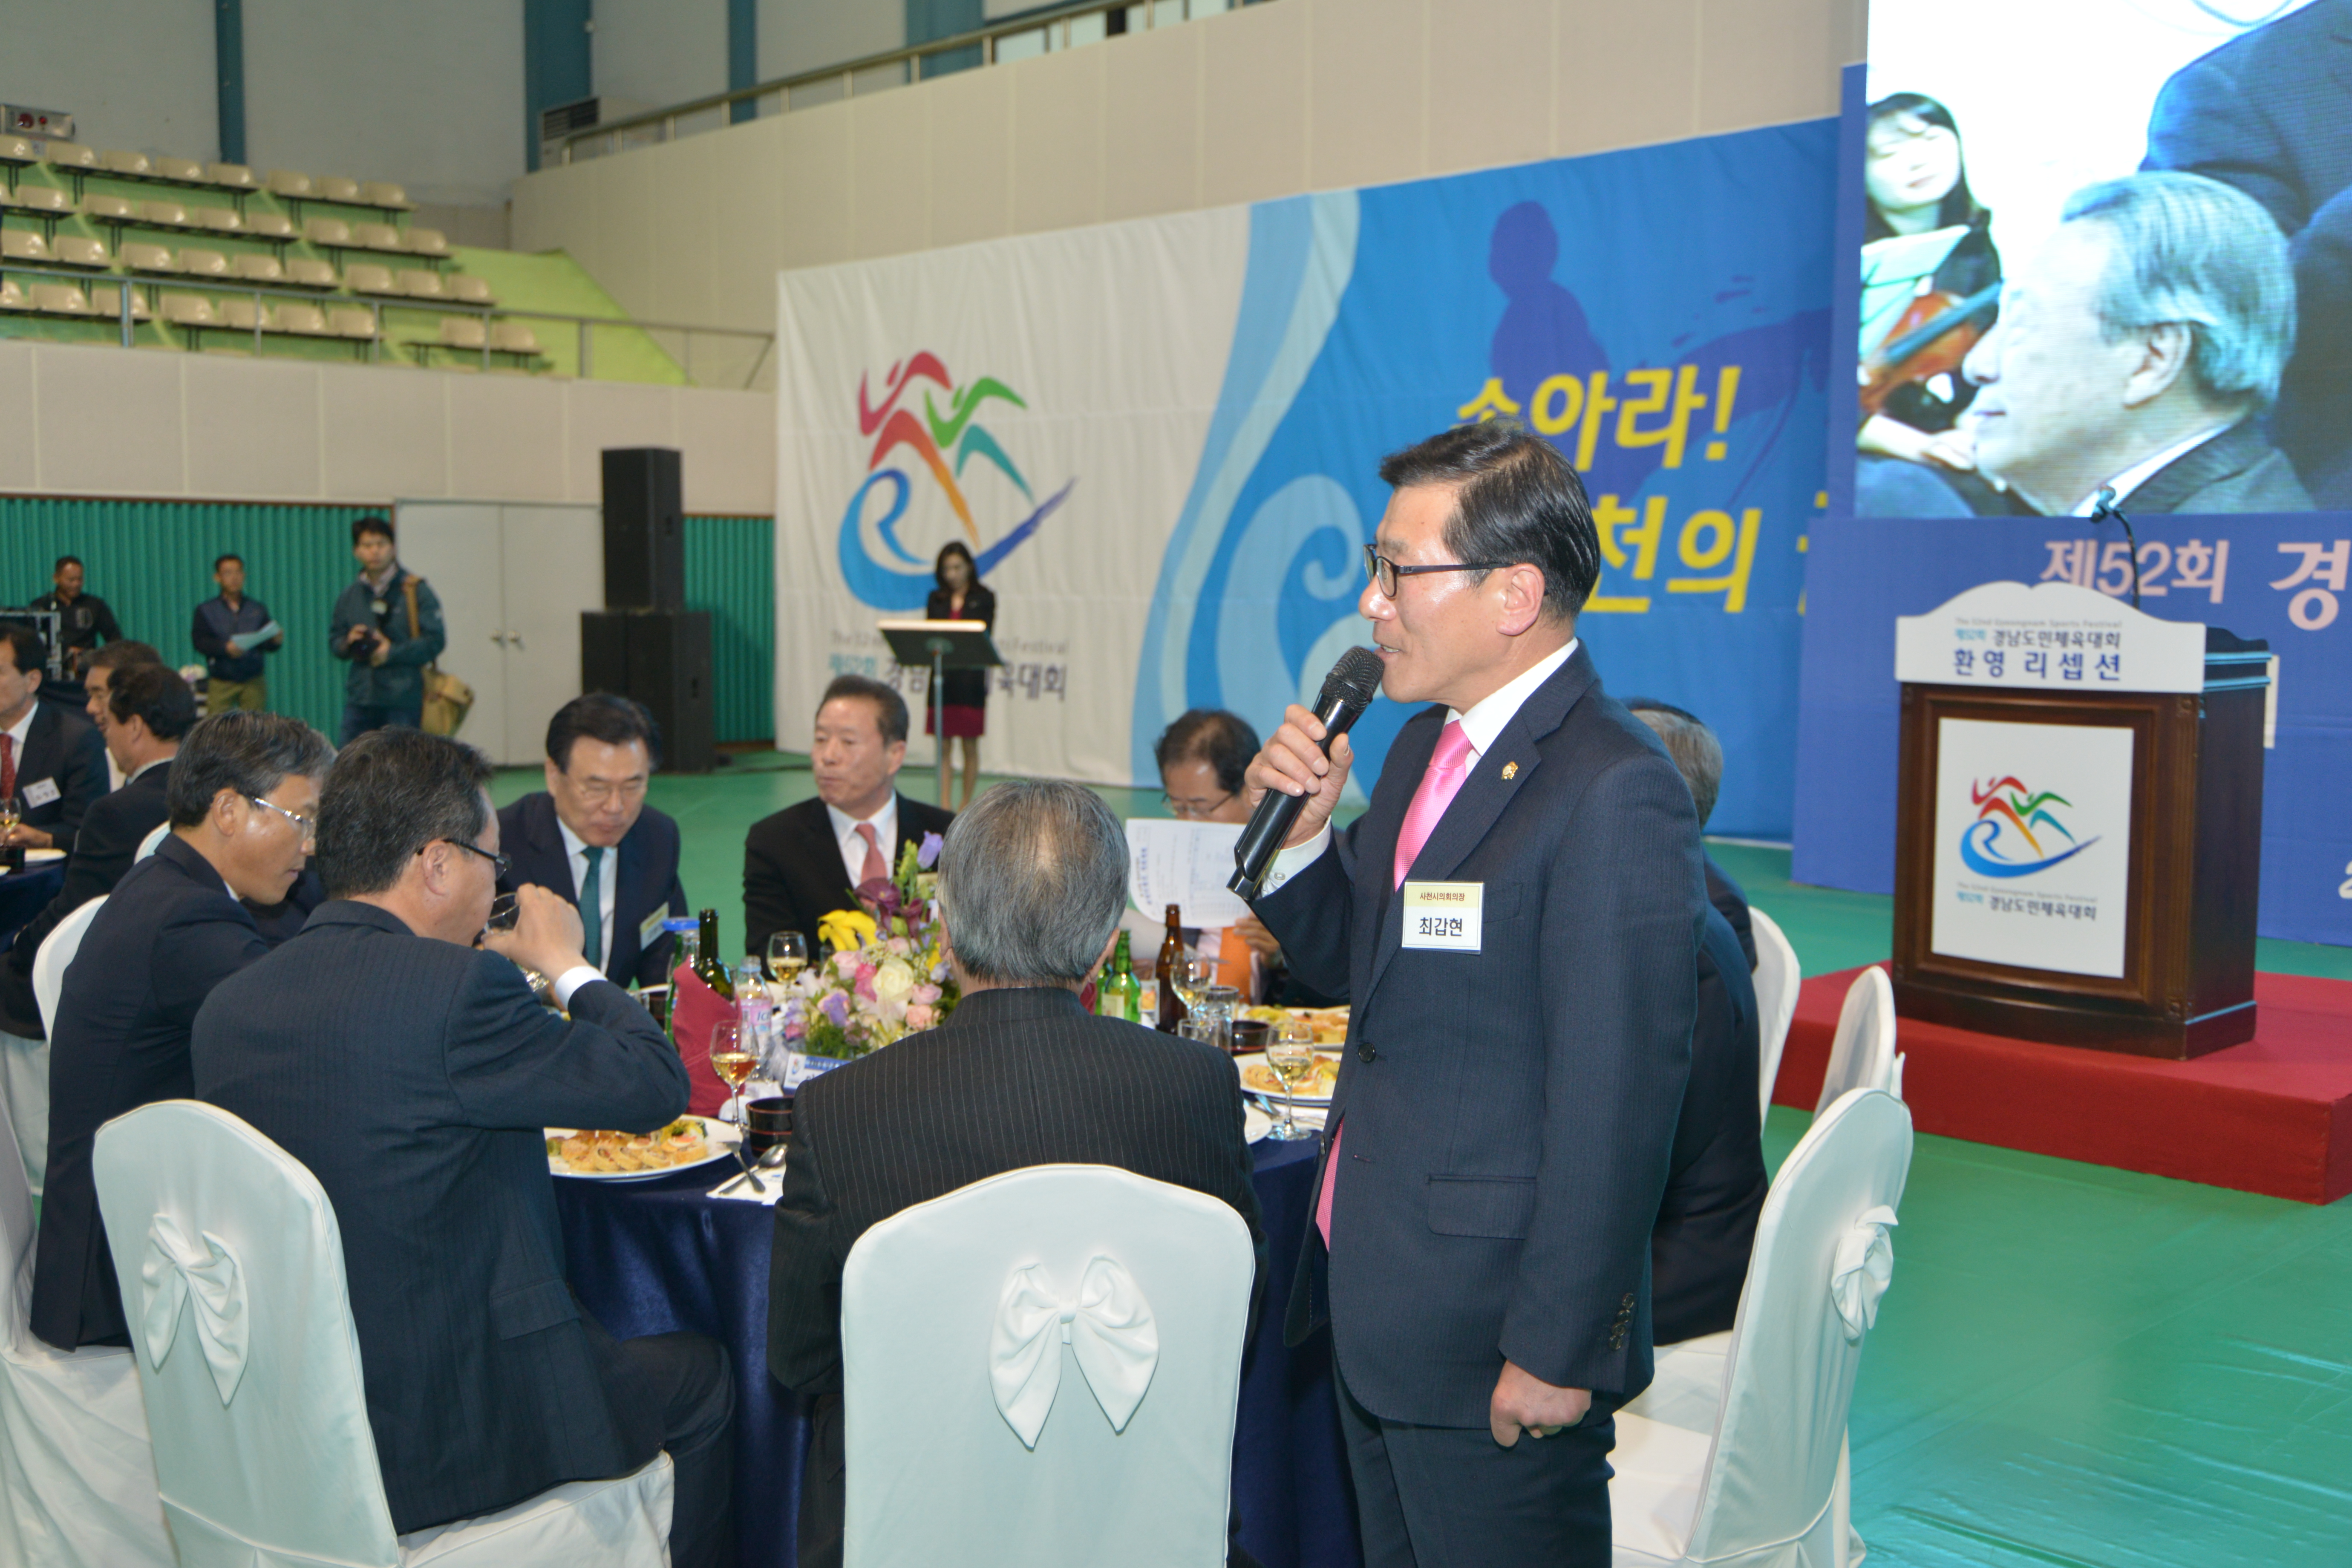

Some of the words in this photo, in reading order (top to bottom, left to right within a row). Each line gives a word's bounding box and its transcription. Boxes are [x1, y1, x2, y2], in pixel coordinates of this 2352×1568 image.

[2039, 539, 2229, 604] 제52회
[1993, 629, 2121, 649] 경남도민체육대회
[1954, 648, 2005, 678] 환영
[2024, 651, 2121, 681] 리셉션
[1420, 892, 1465, 901] 사천시의회의장
[1419, 917, 1463, 937] 최갑현
